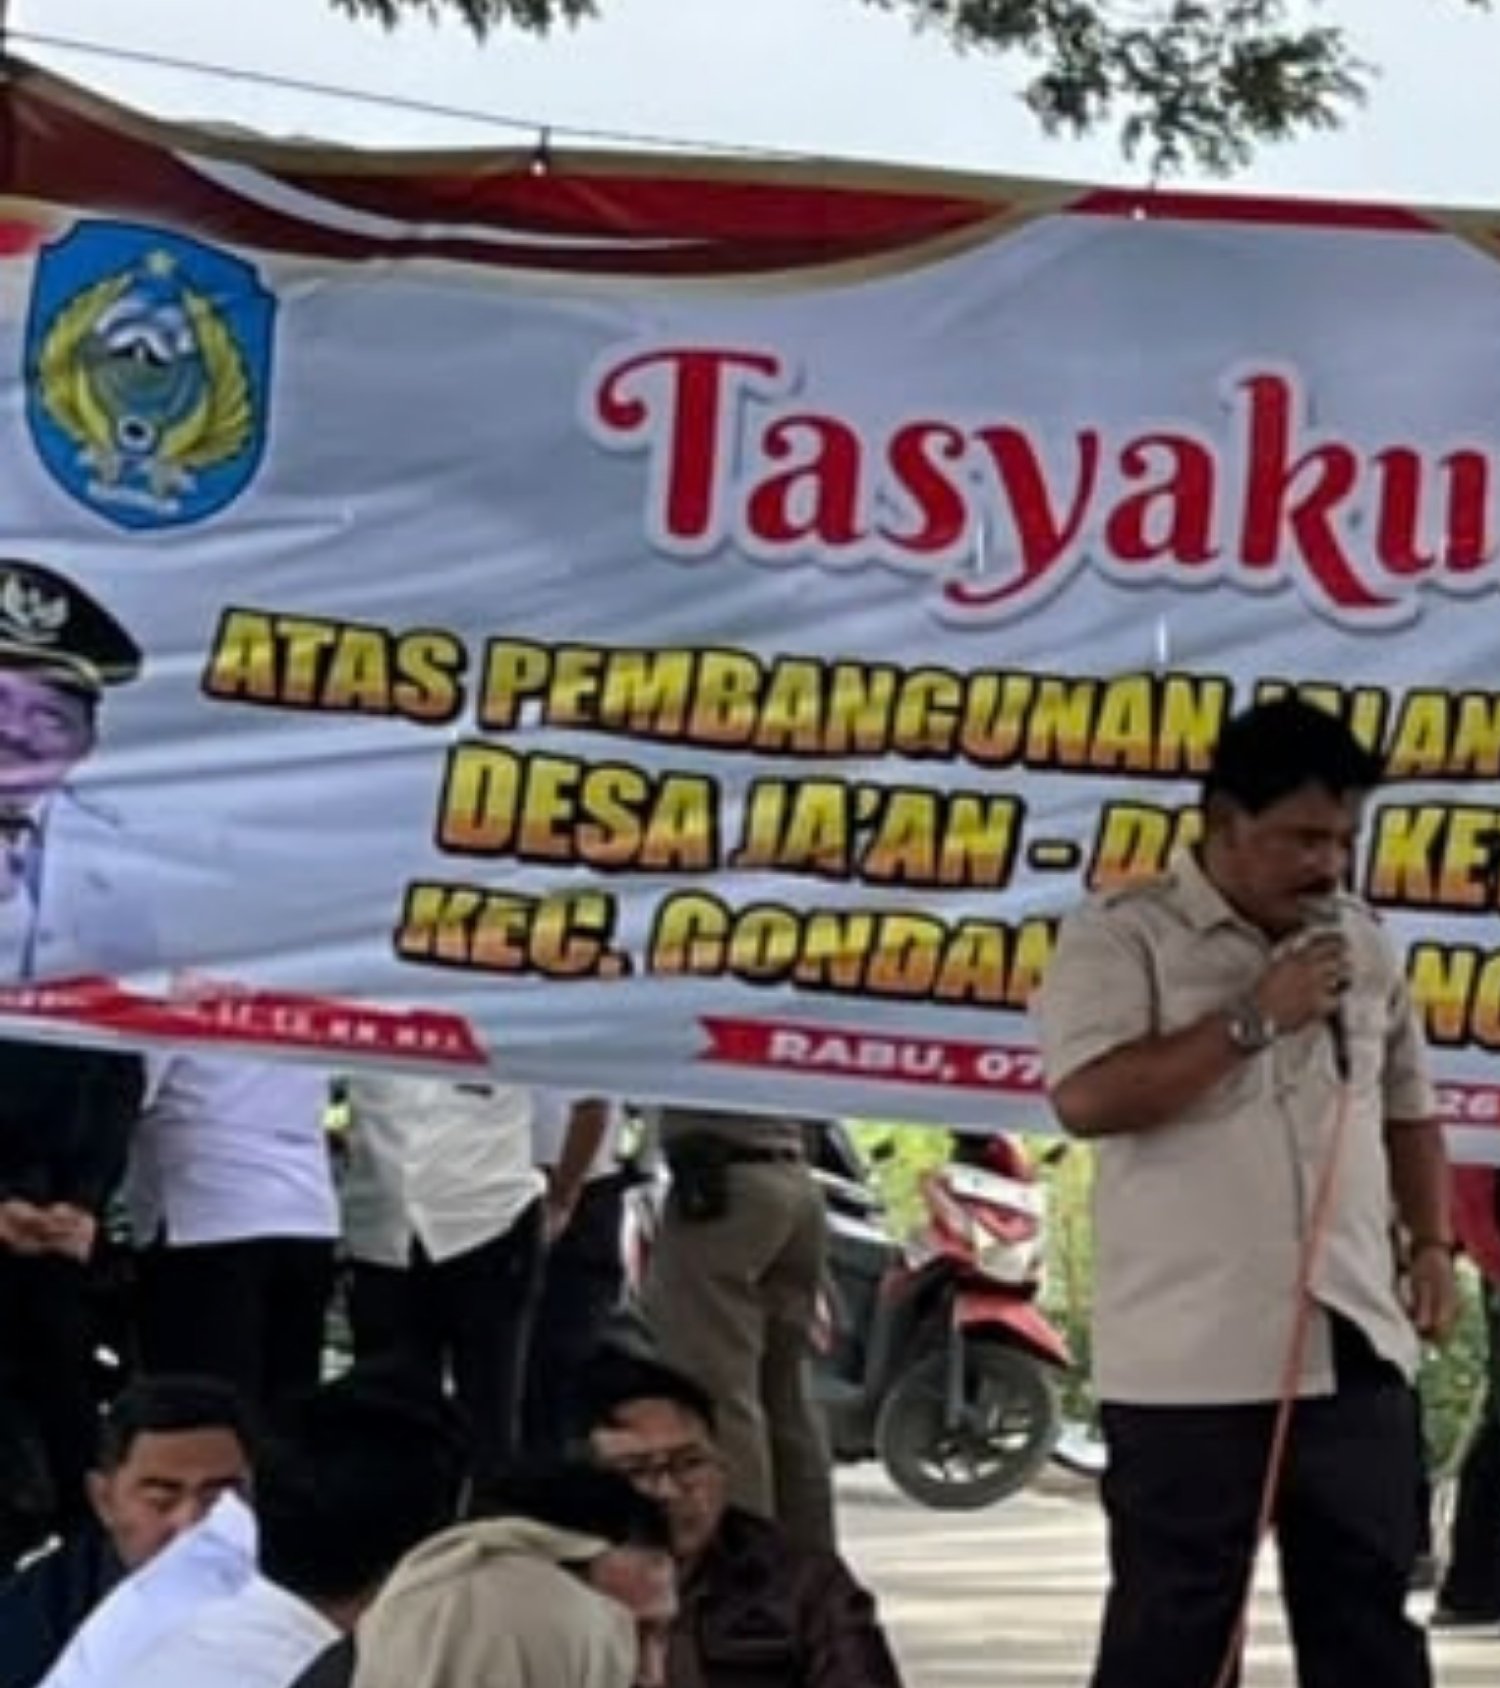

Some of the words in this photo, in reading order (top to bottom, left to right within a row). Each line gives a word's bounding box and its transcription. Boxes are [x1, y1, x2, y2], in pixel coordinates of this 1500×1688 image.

[203, 608, 467, 725] ATAS
[478, 638, 1230, 776] PEMBANGUNAN
[438, 743, 718, 872] DESA
[728, 780, 1024, 888] JA'AN
[396, 883, 634, 978] KEC.
[767, 1028, 956, 1081] RABU,
